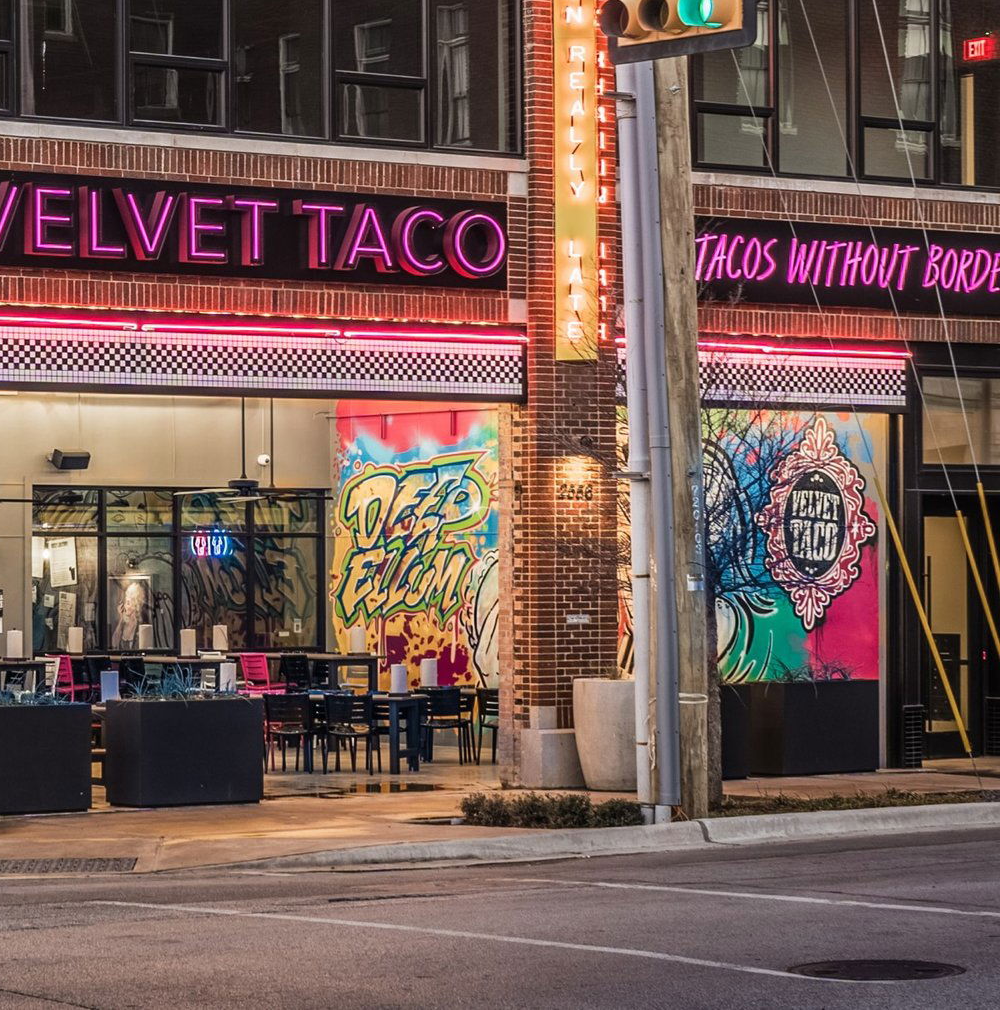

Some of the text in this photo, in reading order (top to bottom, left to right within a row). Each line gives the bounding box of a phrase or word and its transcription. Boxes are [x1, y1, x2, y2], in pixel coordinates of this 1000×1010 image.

[968, 39, 986, 57] EXIT
[568, 45, 586, 199] REALLY
[293, 200, 508, 279] TACO
[695, 233, 778, 282] TACOS
[786, 237, 920, 291] WITHOUT
[567, 240, 584, 340] LATE
[346, 459, 484, 556] DEEP
[790, 519, 839, 561] TACO
[791, 490, 841, 521] VELVET
[338, 544, 472, 621] ELLUM
